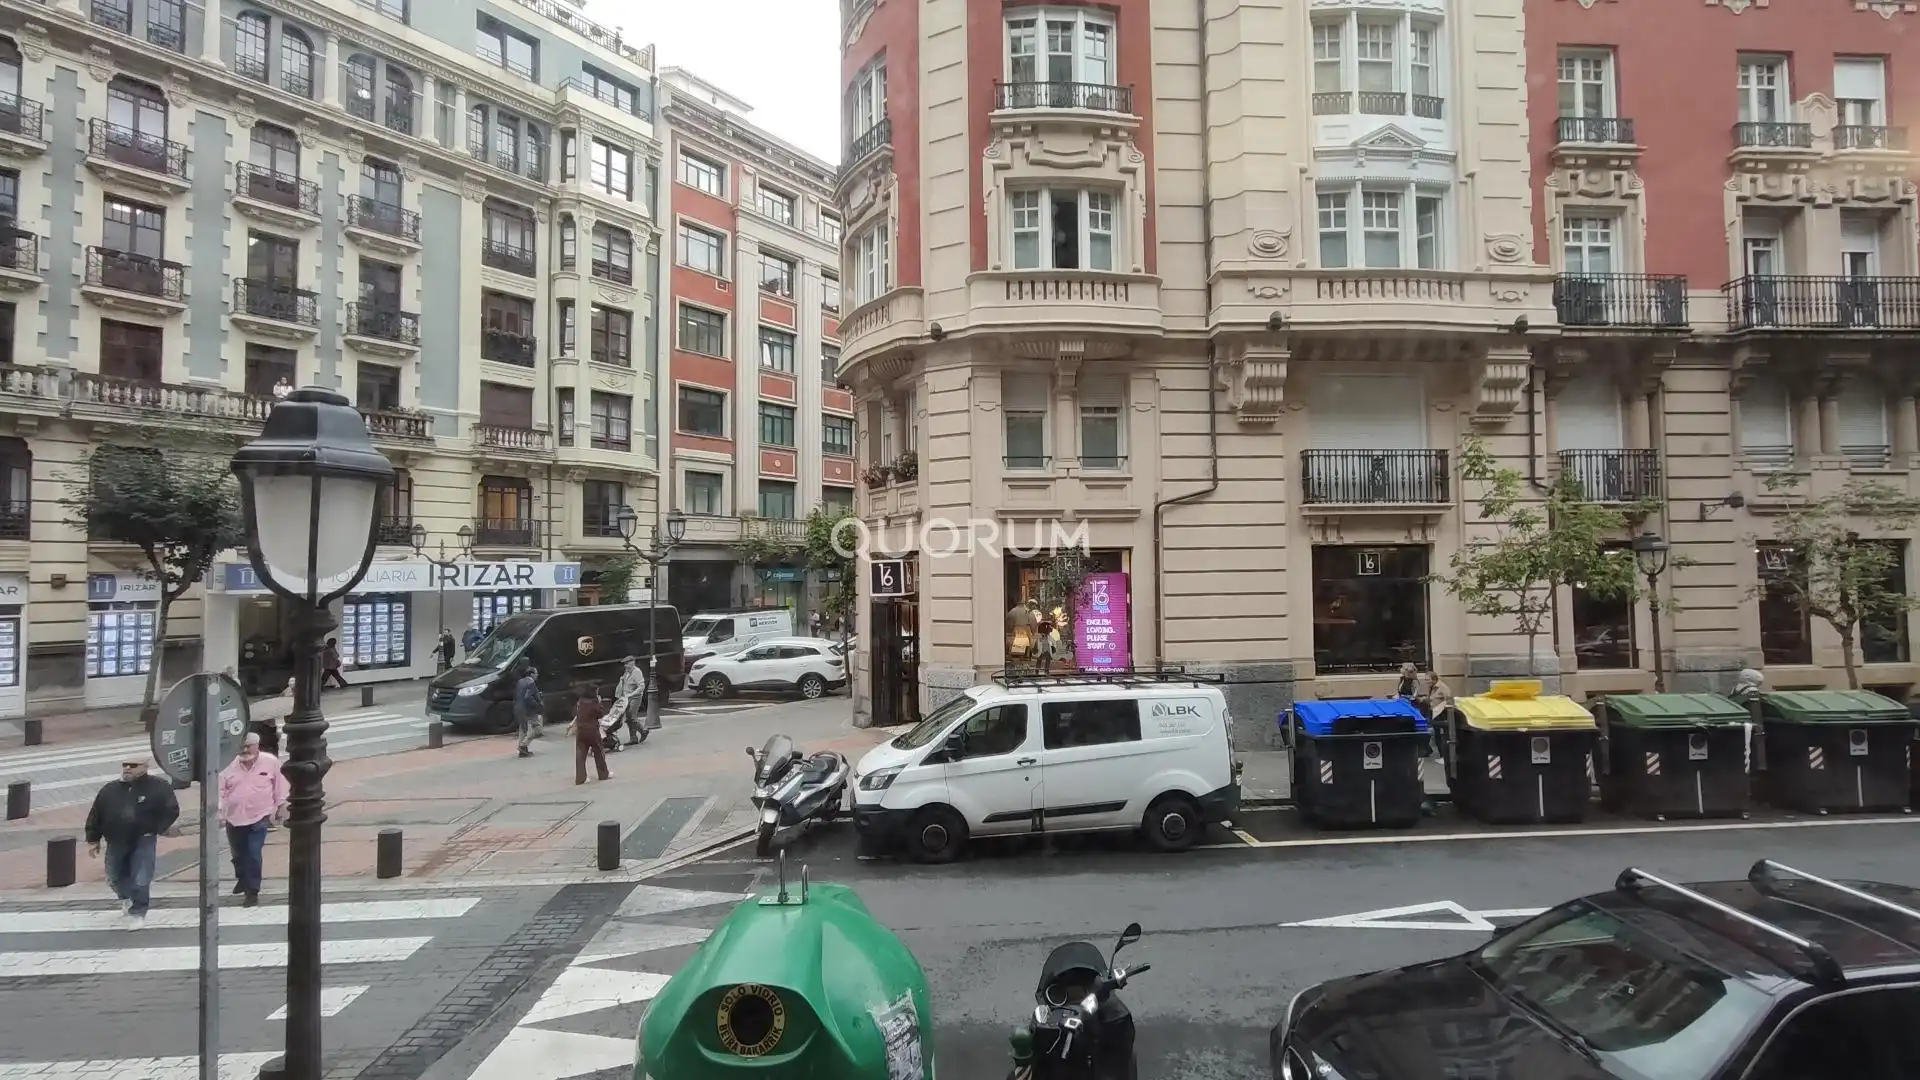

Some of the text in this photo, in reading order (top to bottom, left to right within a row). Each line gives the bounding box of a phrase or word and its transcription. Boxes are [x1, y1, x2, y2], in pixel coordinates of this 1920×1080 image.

[429, 564, 534, 586] IRIZAR
[879, 563, 894, 586] 16
[1090, 580, 1109, 606] 16
[1167, 705, 1201, 717] LBK
[721, 985, 783, 1016] SOLO VIDRIO
[719, 1024, 783, 1056] BEIRA BAKARRIK
